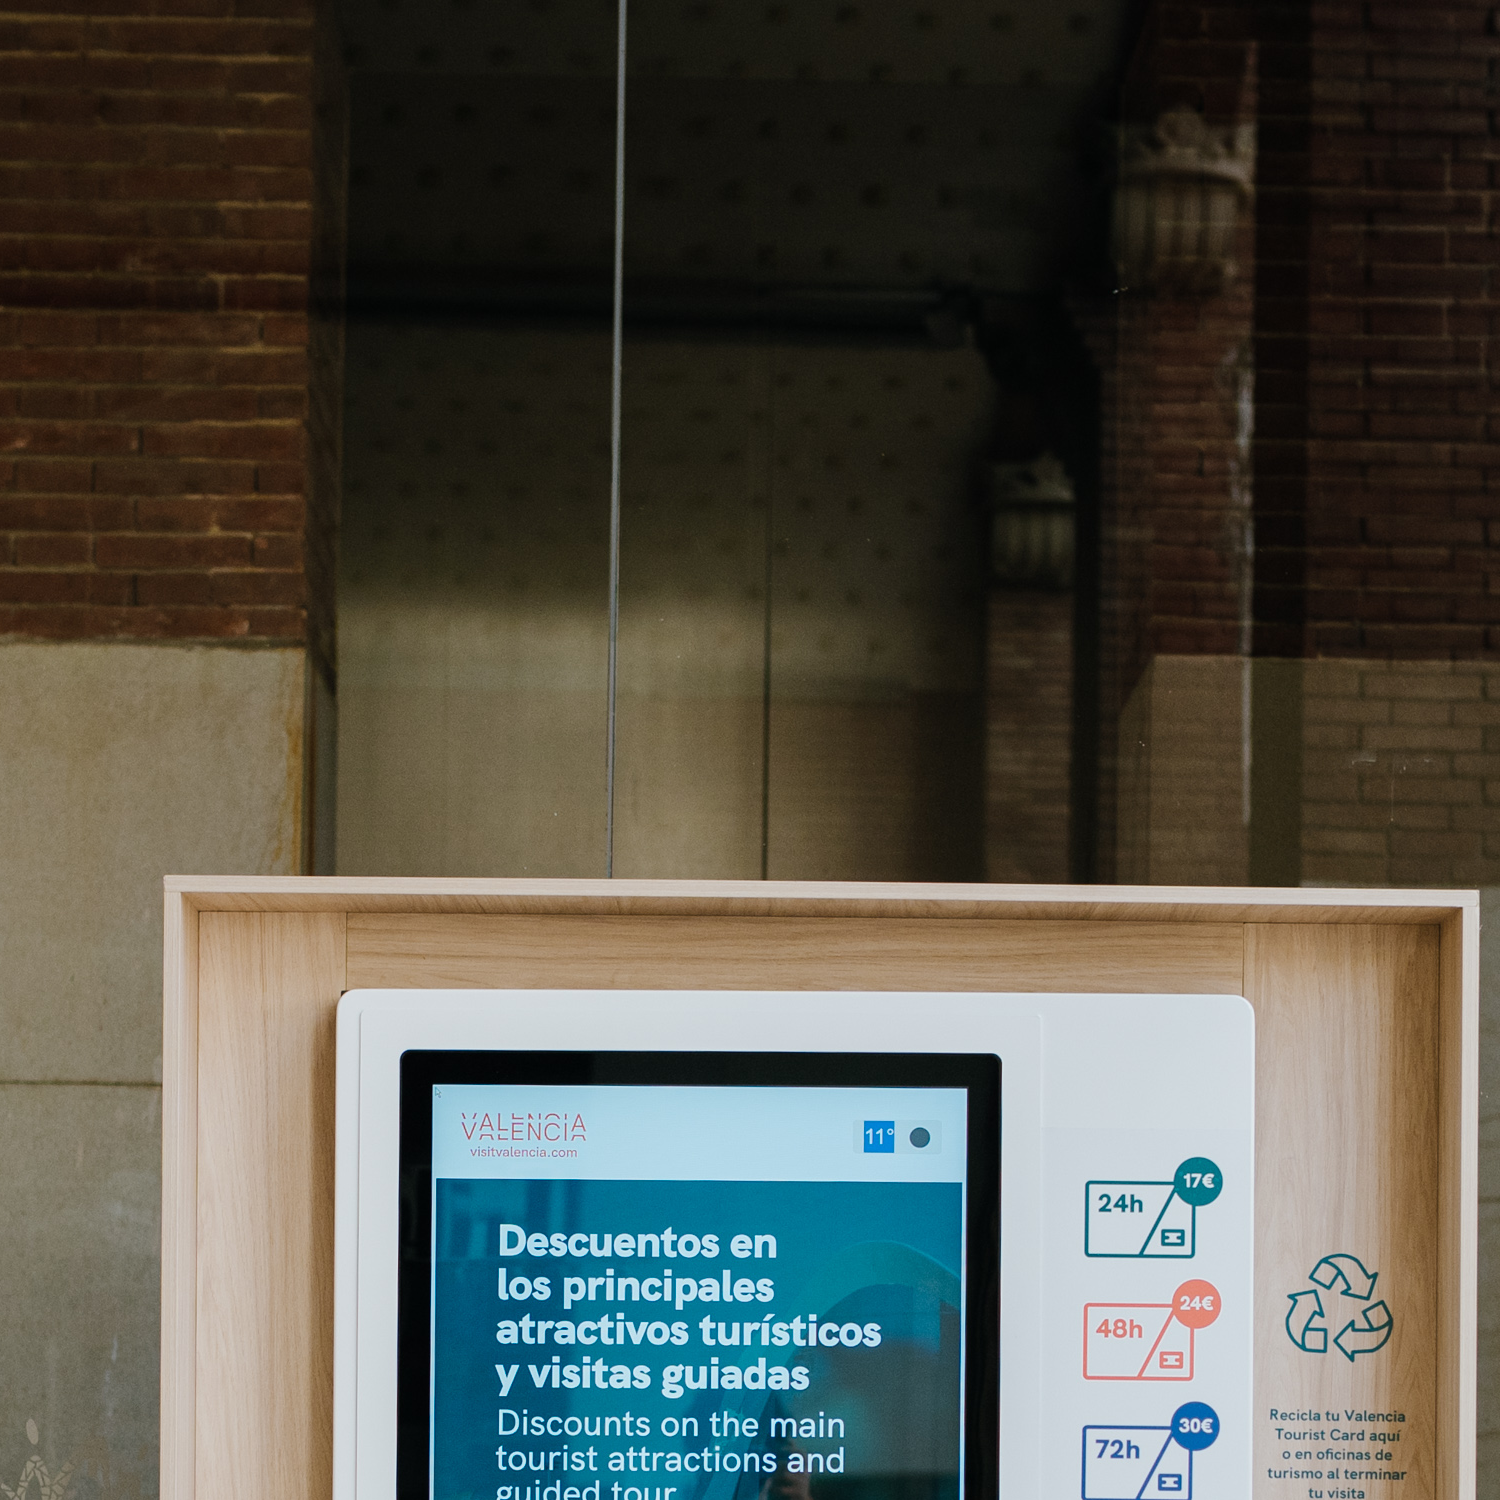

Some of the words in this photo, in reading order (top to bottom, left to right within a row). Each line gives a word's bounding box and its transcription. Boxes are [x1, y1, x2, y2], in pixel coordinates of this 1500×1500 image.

[865, 1127, 895, 1145] 11°
[470, 1145, 578, 1158] visitvalencia.com
[1183, 1172, 1215, 1189] 17€
[1098, 1193, 1144, 1213] 24h
[500, 1224, 719, 1258] Descuentos
[730, 1234, 776, 1258] en
[498, 1268, 551, 1300] los
[564, 1269, 774, 1310] principales
[1179, 1295, 1214, 1311] 24€
[496, 1313, 689, 1345] atractivos
[699, 1314, 881, 1347] turísticos
[1095, 1318, 1143, 1339] 48h
[495, 1365, 519, 1396] y
[528, 1356, 651, 1389] visitas
[662, 1357, 809, 1398] guiadas
[499, 1409, 650, 1436] Discounts
[660, 1416, 699, 1437] on
[709, 1411, 758, 1437] the
[771, 1412, 844, 1437] main
[1269, 1408, 1321, 1422] Recicla
[1324, 1410, 1340, 1422] tu
[1344, 1409, 1406, 1423] Valencia
[1178, 1417, 1214, 1434] 30€
[1274, 1427, 1326, 1441] Tourist
[1329, 1428, 1365, 1442] Card
[1369, 1429, 1401, 1445] aquí
[1095, 1439, 1140, 1460] 72h
[1282, 1450, 1291, 1460] o
[1294, 1450, 1312, 1460] en
[1316, 1447, 1372, 1461] oficinas
[1374, 1448, 1393, 1462] de
[496, 1445, 597, 1471] tourist
[608, 1446, 777, 1472] attractions
[787, 1447, 844, 1473] and
[1267, 1466, 1324, 1480] turismo
[1326, 1467, 1340, 1480] al
[1343, 1467, 1408, 1481] terminar
[1308, 1487, 1323, 1499] tu
[1326, 1486, 1365, 1500] visita
